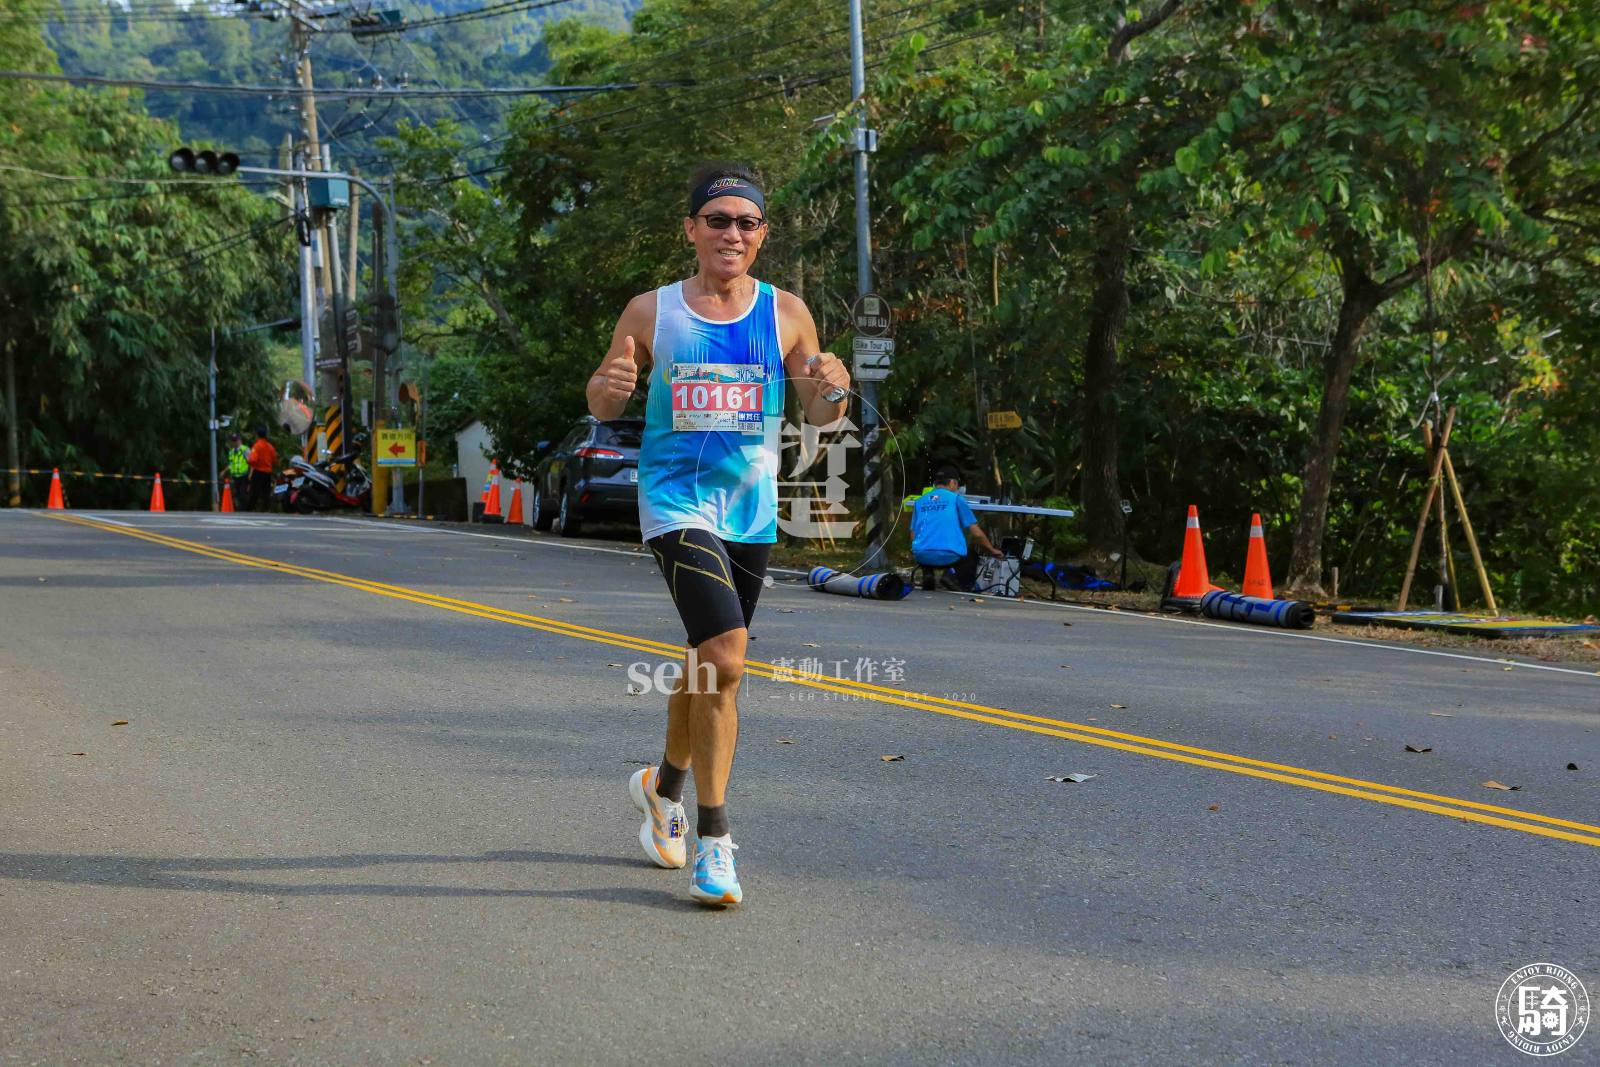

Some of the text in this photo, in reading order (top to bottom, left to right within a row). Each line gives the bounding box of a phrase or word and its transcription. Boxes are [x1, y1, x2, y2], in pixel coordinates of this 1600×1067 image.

[870, 340, 883, 349] Tour
[676, 386, 757, 410] 10161
[921, 504, 948, 512] STAFF
